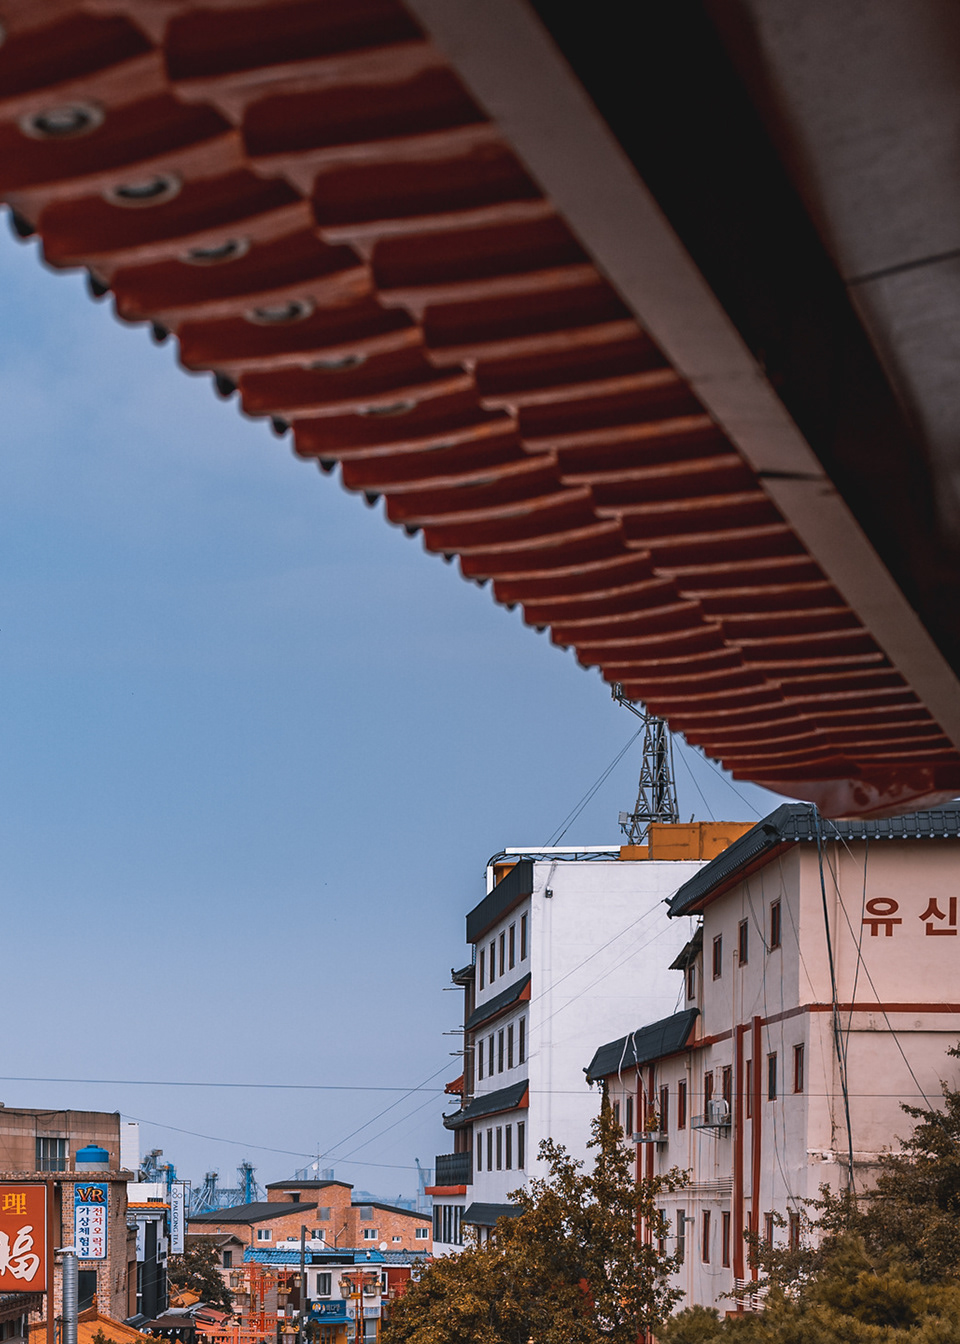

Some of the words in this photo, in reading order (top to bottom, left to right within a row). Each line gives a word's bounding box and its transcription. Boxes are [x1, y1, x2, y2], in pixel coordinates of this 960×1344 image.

[862, 896, 958, 937] 유신
[77, 1186, 106, 1203] VR
[78, 1207, 91, 1257] 가상체험실
[92, 1206, 103, 1257] 전자오락실
